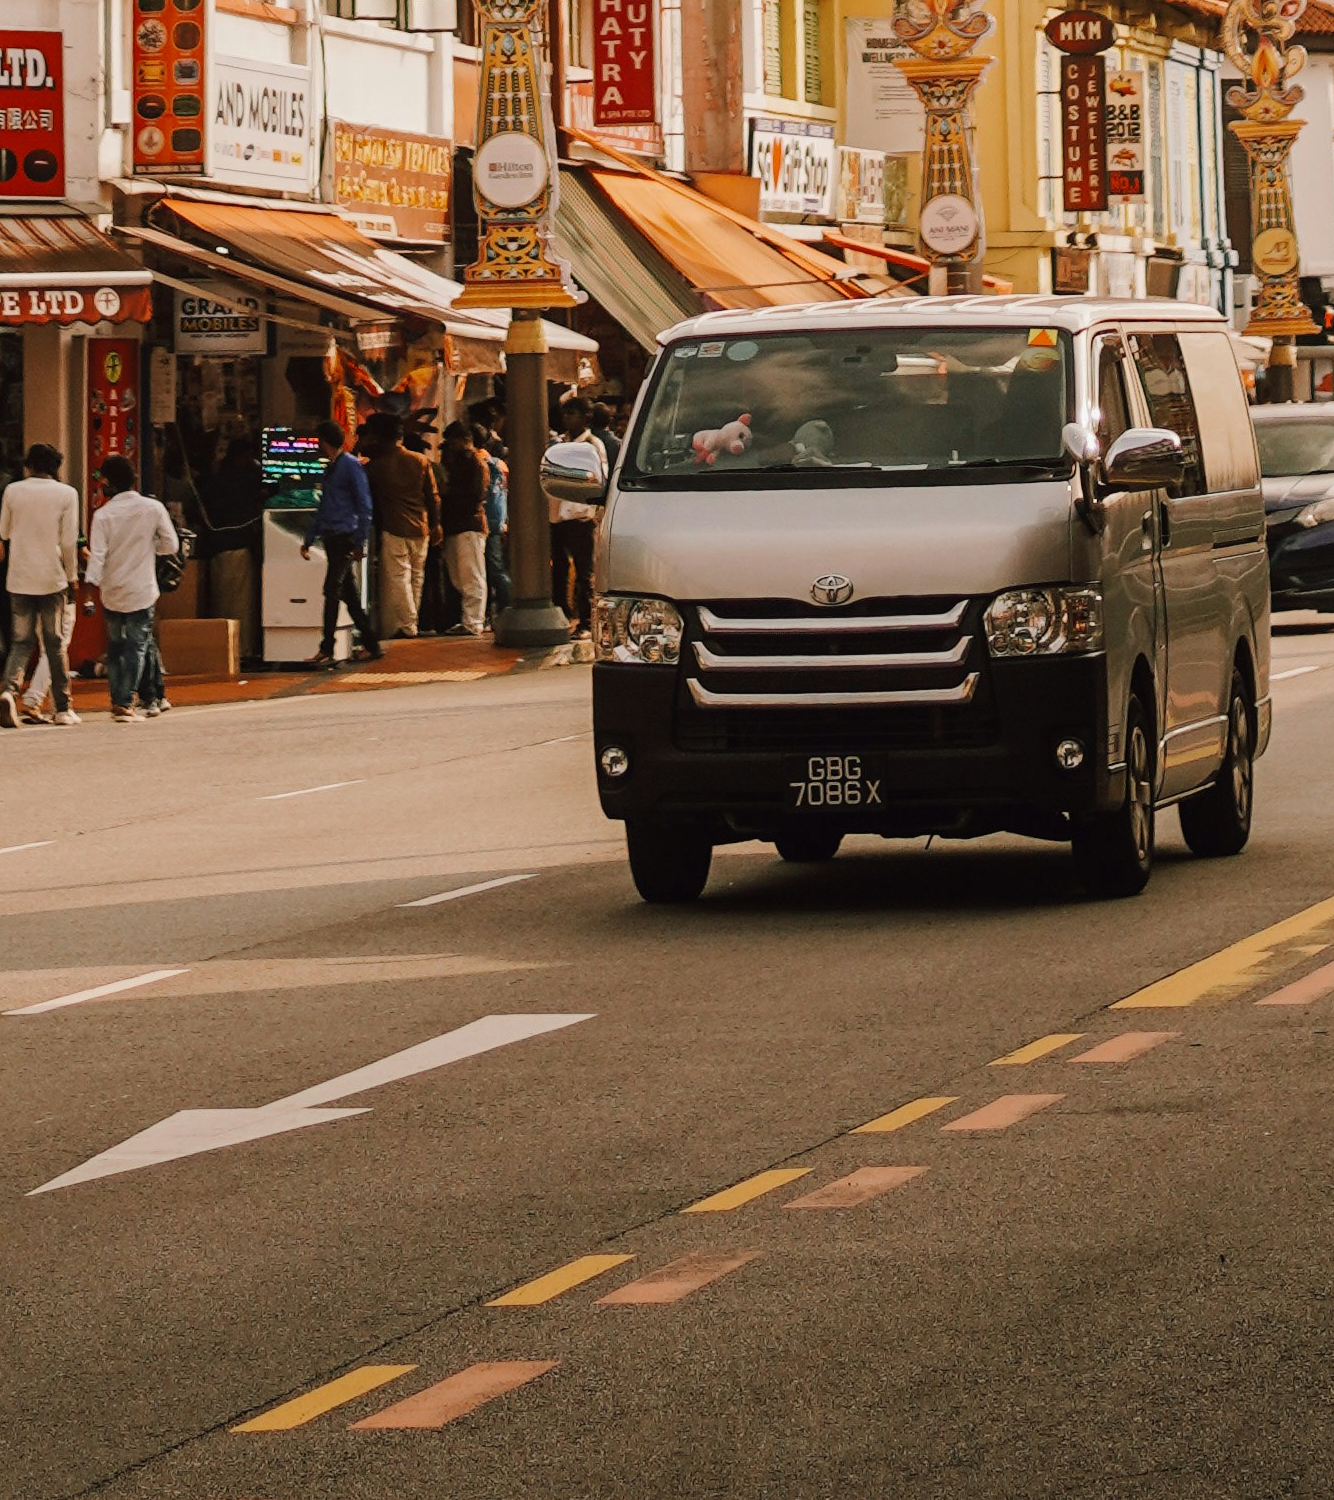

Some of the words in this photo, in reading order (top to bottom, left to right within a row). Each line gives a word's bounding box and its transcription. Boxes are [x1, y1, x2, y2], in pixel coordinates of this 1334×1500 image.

[1059, 20, 1102, 41] MKM
[249, 85, 305, 138] MOBILES
[1067, 64, 1083, 203] COSTUME
[1085, 64, 1099, 203] JEWELLERY
[1107, 122, 1141, 138] 2012
[28, 291, 85, 317] LTD
[182, 298, 258, 315] GRAD
[182, 317, 258, 332] MOBILES
[807, 757, 861, 780] GBG
